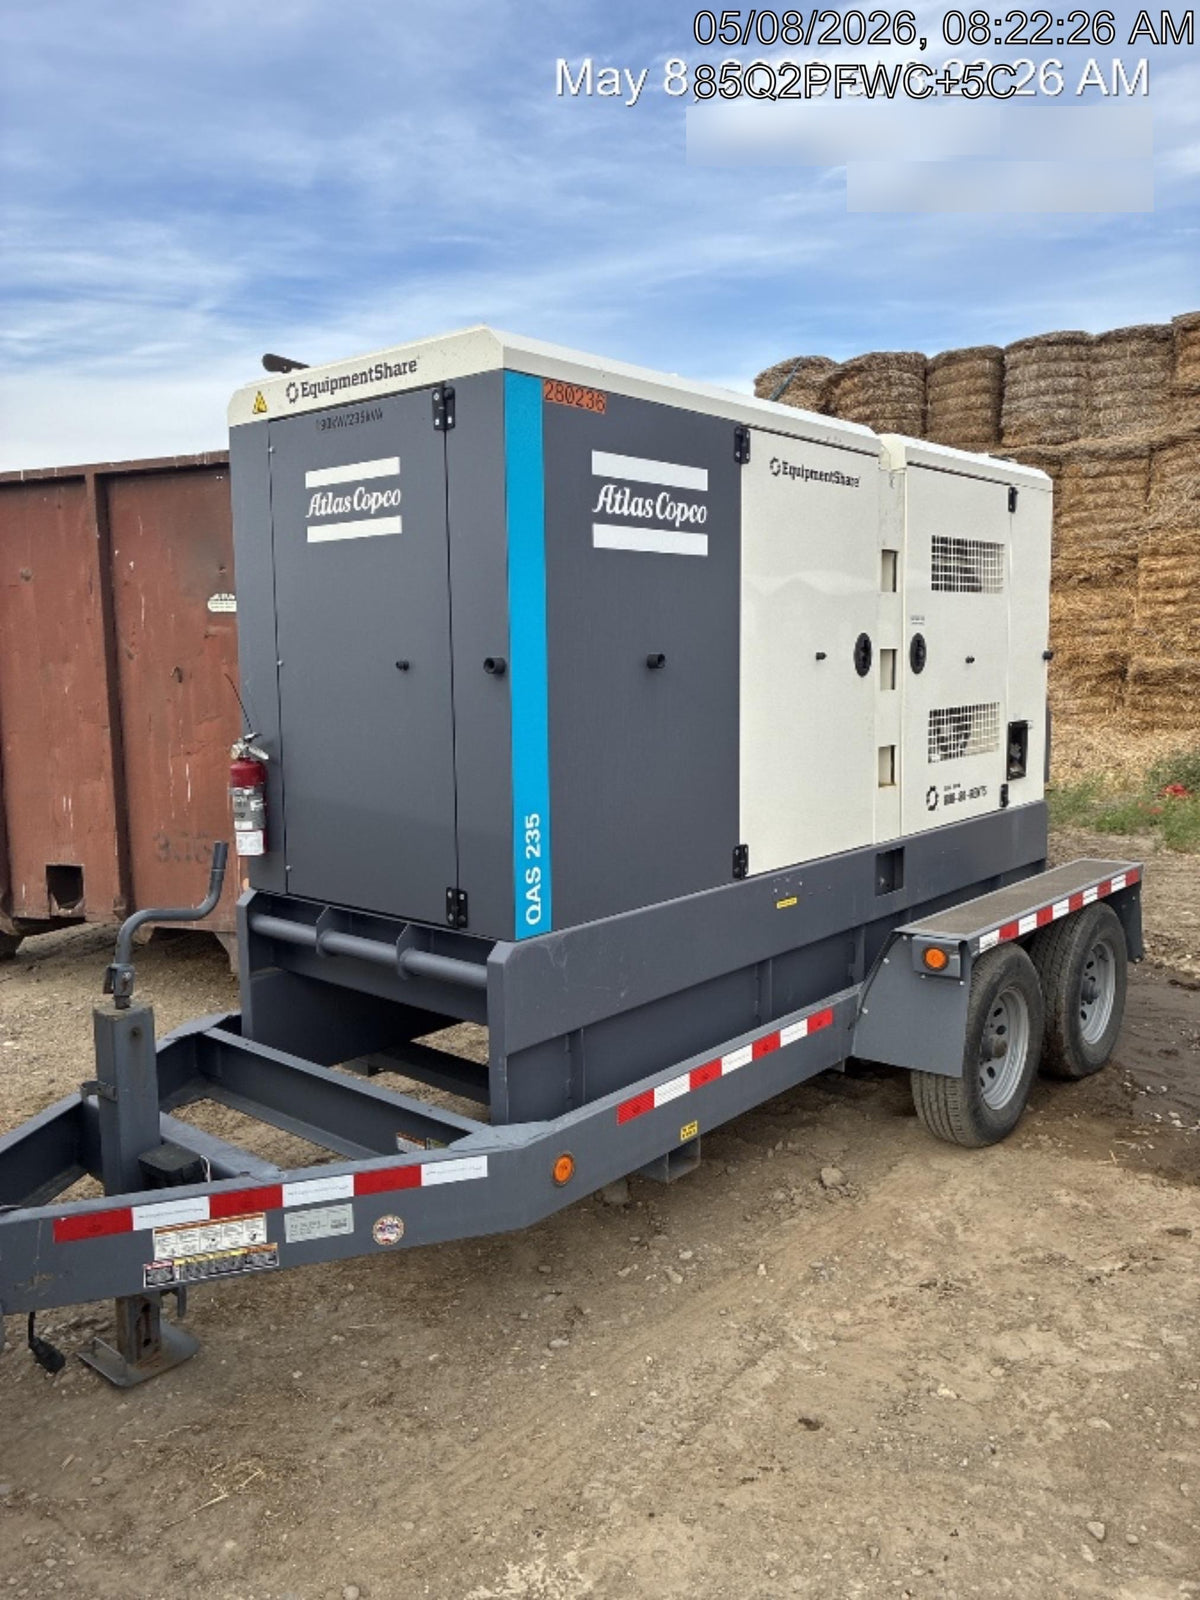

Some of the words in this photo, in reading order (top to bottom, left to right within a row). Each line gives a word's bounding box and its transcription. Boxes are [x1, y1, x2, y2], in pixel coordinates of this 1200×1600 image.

[300, 358, 418, 400] EquipmentShare
[544, 380, 606, 412] 280236
[781, 460, 860, 488] EquipmentShare
[305, 491, 351, 519] Atlas
[353, 486, 402, 516] Copco
[592, 483, 654, 521] Atlas
[656, 491, 708, 528] Copco
[524, 812, 542, 860] 235
[524, 865, 542, 926] QAS
